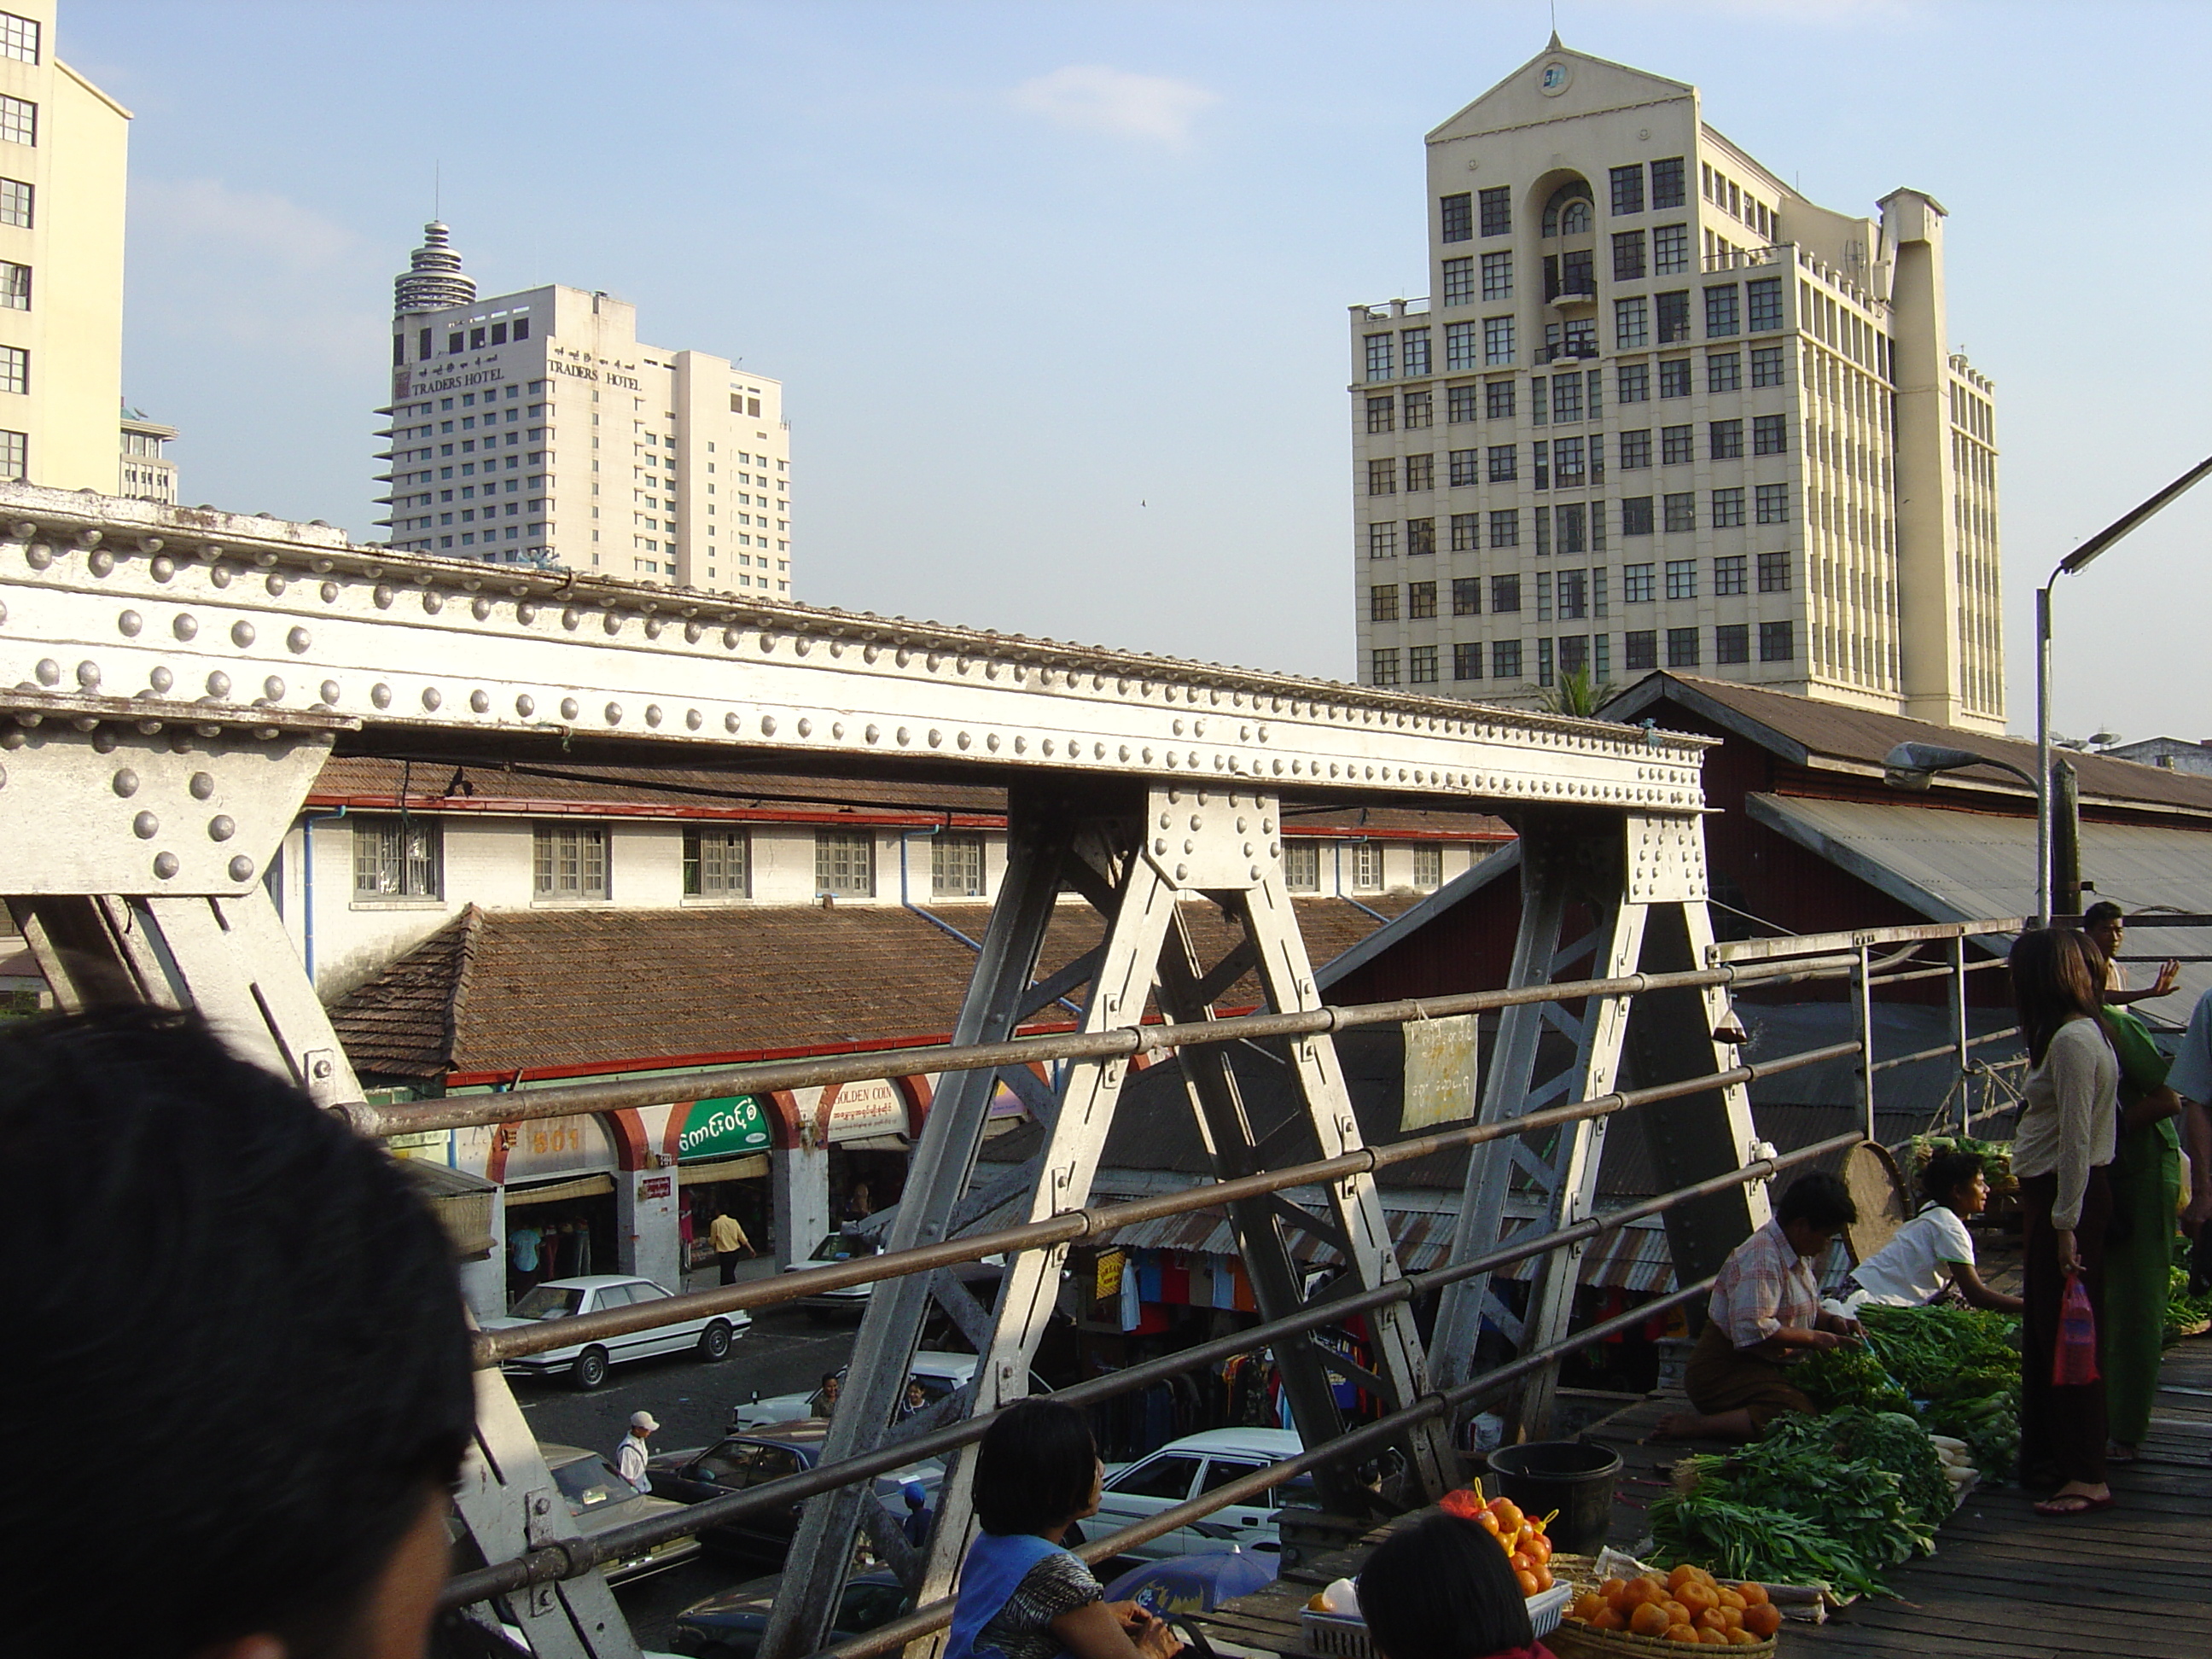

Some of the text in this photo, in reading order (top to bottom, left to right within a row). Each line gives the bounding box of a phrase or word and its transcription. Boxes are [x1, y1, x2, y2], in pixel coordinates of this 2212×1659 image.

[412, 368, 504, 396] TRADERS HOTEL
[547, 358, 642, 391] TRADERS HOTEL
[872, 1086, 892, 1101] COIN
